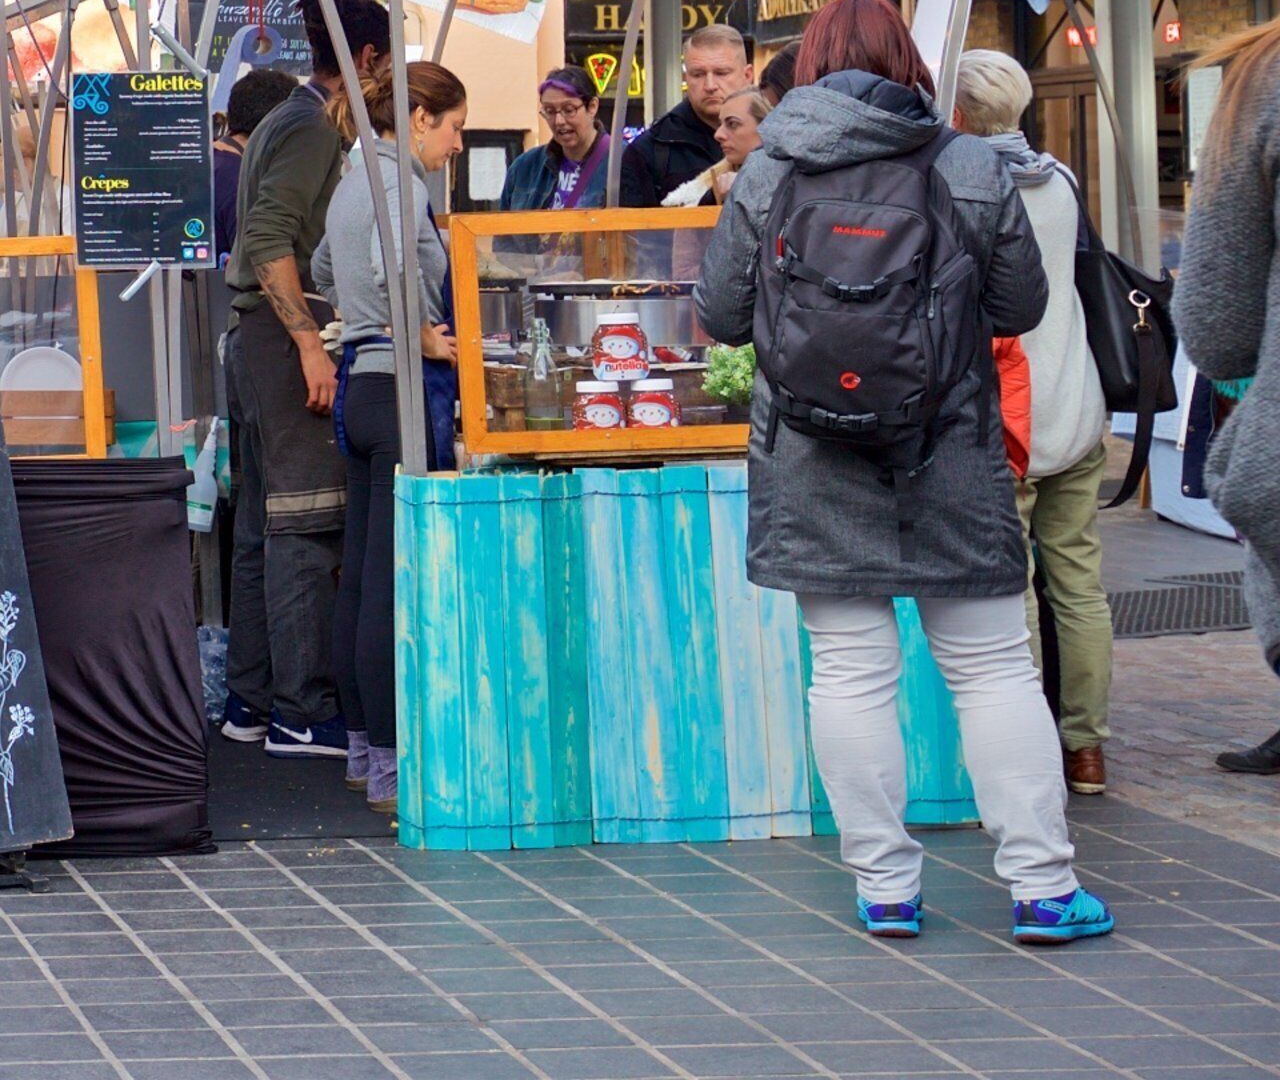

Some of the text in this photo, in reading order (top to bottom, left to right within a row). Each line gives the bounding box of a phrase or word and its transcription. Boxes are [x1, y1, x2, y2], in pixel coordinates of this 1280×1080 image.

[130, 74, 204, 92] Galettes
[81, 173, 130, 193] Crêpes
[832, 225, 887, 239] MAMMUT
[604, 359, 643, 372] nutella
